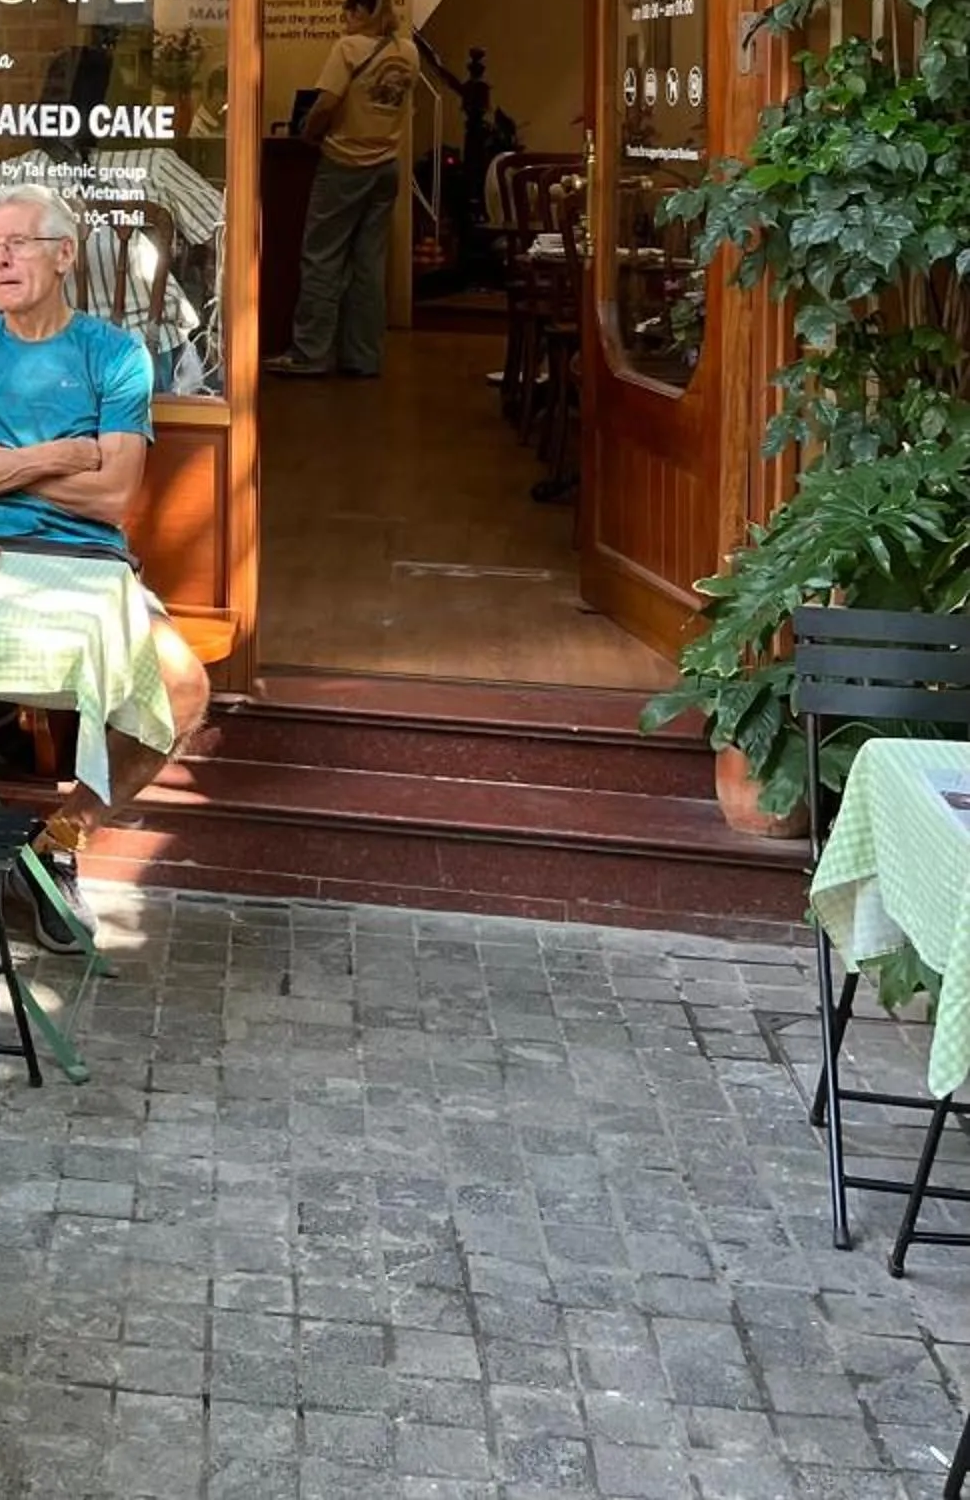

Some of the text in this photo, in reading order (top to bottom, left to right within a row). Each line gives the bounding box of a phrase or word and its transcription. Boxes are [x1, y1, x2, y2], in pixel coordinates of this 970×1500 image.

[88, 104, 176, 139] CAKE
[1, 160, 20, 179] by
[47, 163, 97, 179] ethnic
[98, 166, 147, 182] group
[61, 183, 79, 199] of
[79, 185, 146, 201] Vietnam
